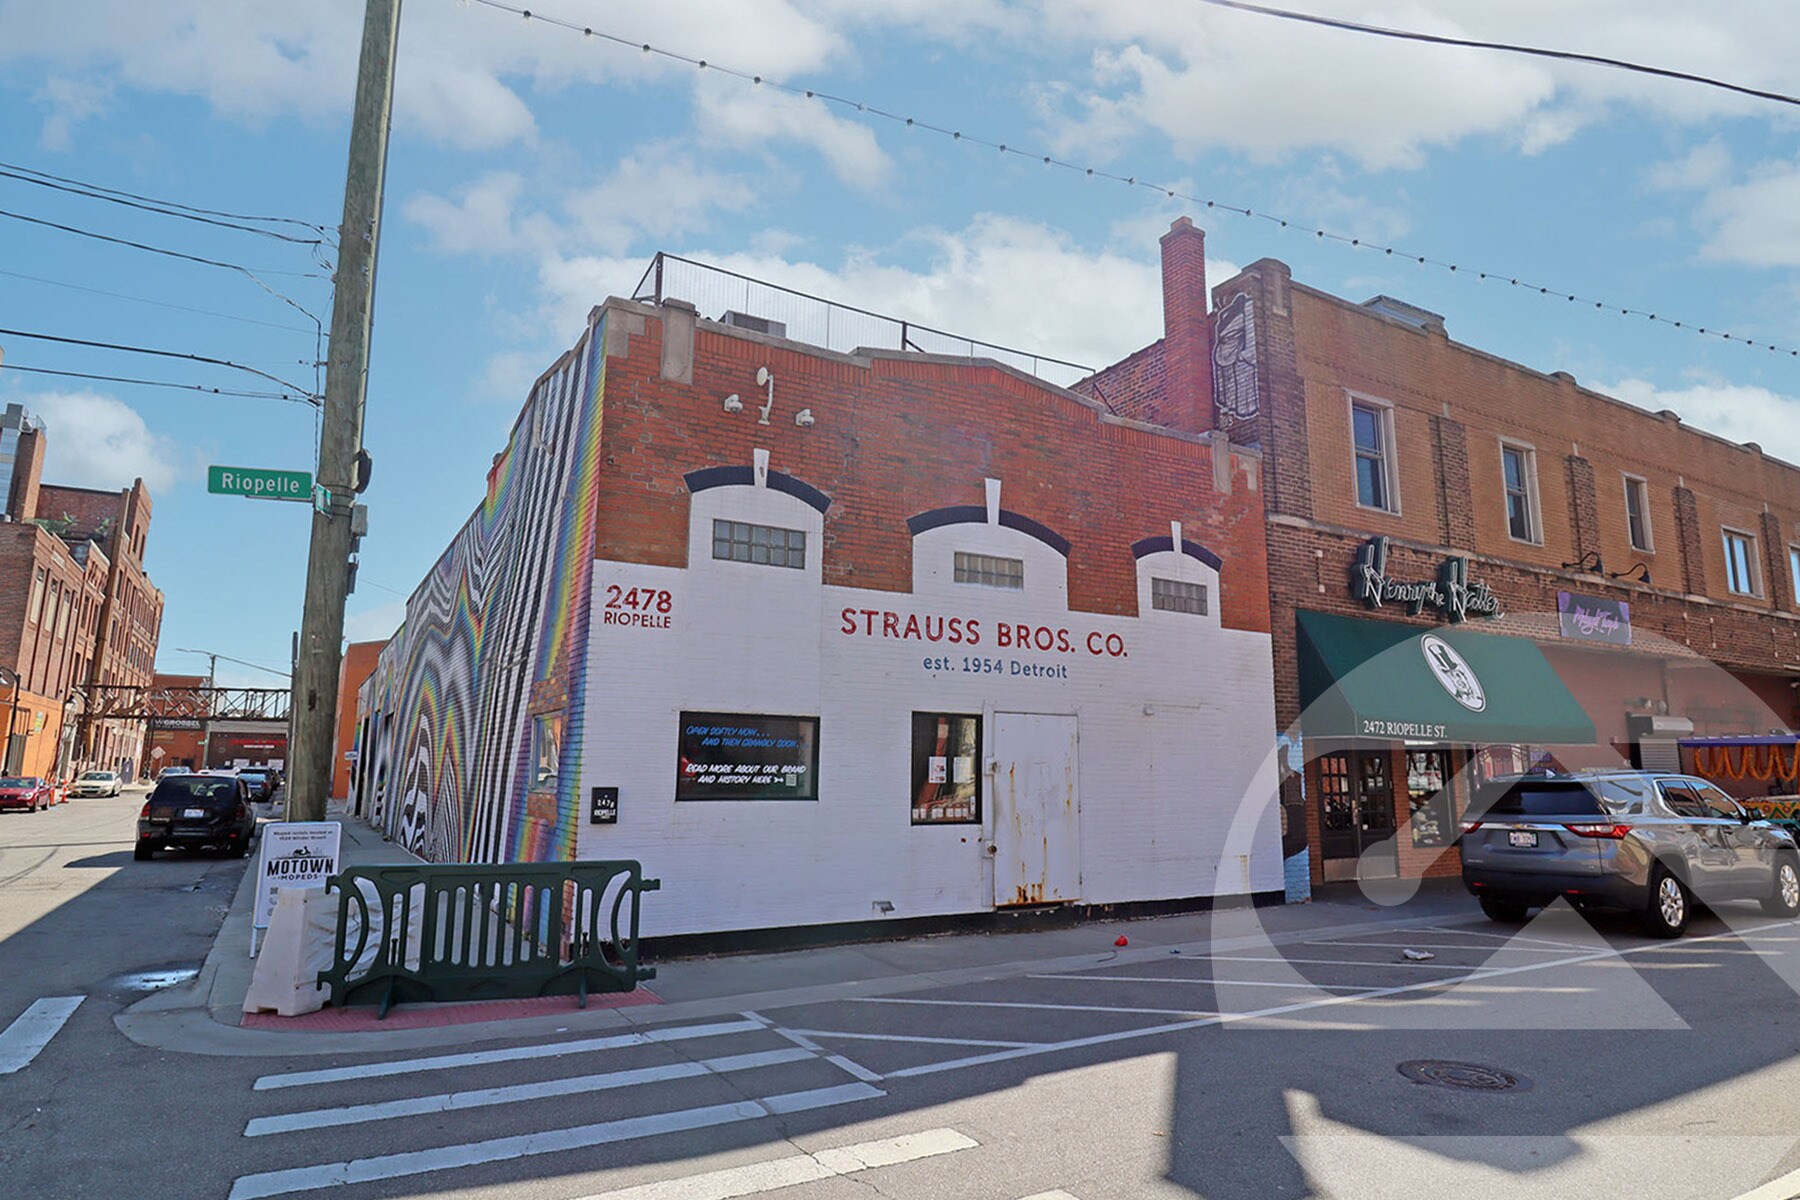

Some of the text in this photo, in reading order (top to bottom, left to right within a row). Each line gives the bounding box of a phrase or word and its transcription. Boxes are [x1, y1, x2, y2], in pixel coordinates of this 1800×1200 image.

[222, 472, 299, 494] Riopelle
[1362, 536, 1505, 623] Henry the Hatter
[604, 584, 673, 614] 2478
[603, 611, 672, 629] RIOPELLE
[840, 607, 1129, 658] STRAUSS BROS. CO.
[923, 656, 1068, 679] est. 1954 Detroit
[685, 725, 711, 736] OPEN
[1363, 720, 1448, 738] 2472 RIOPELLE ST.
[701, 737, 721, 747] AND
[721, 738, 741, 747] THEN
[685, 763, 807, 775] READ MORE ABOUT OUR BRAND
[697, 774, 773, 784] AND HISTORY HERE
[267, 858, 334, 877] MOTOWN
[280, 873, 319, 881] MOPEDS
